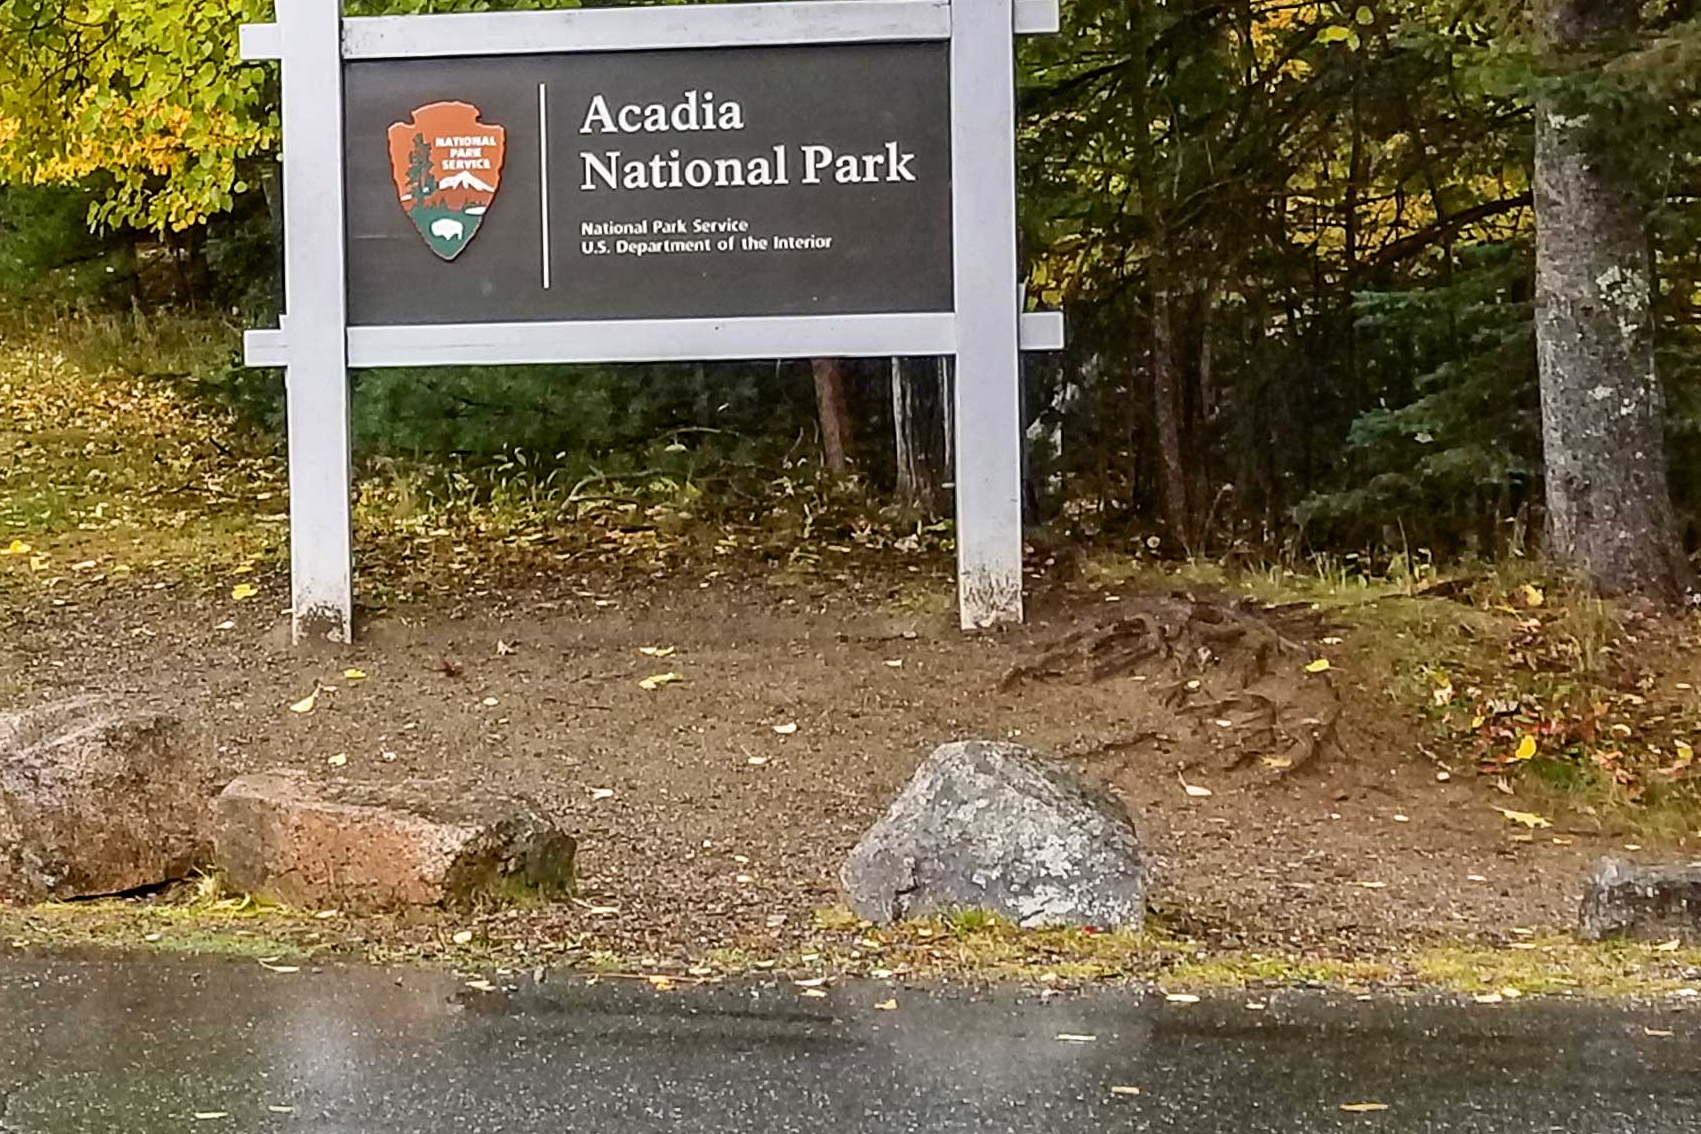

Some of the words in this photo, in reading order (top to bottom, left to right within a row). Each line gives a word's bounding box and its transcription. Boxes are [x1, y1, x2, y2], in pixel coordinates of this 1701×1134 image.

[579, 90, 744, 134] Acadia
[435, 136, 497, 147] NATIONAL
[450, 147, 482, 158] PARK
[441, 158, 491, 170] SERVICE
[580, 144, 789, 190] National
[801, 141, 916, 184] Park
[581, 219, 648, 236] National
[652, 219, 688, 234] Park
[692, 217, 749, 233] Service
[581, 239, 611, 255] U.S.
[616, 238, 711, 257] Department
[717, 235, 736, 251] of
[741, 235, 769, 251] the
[773, 234, 832, 250] Interior
